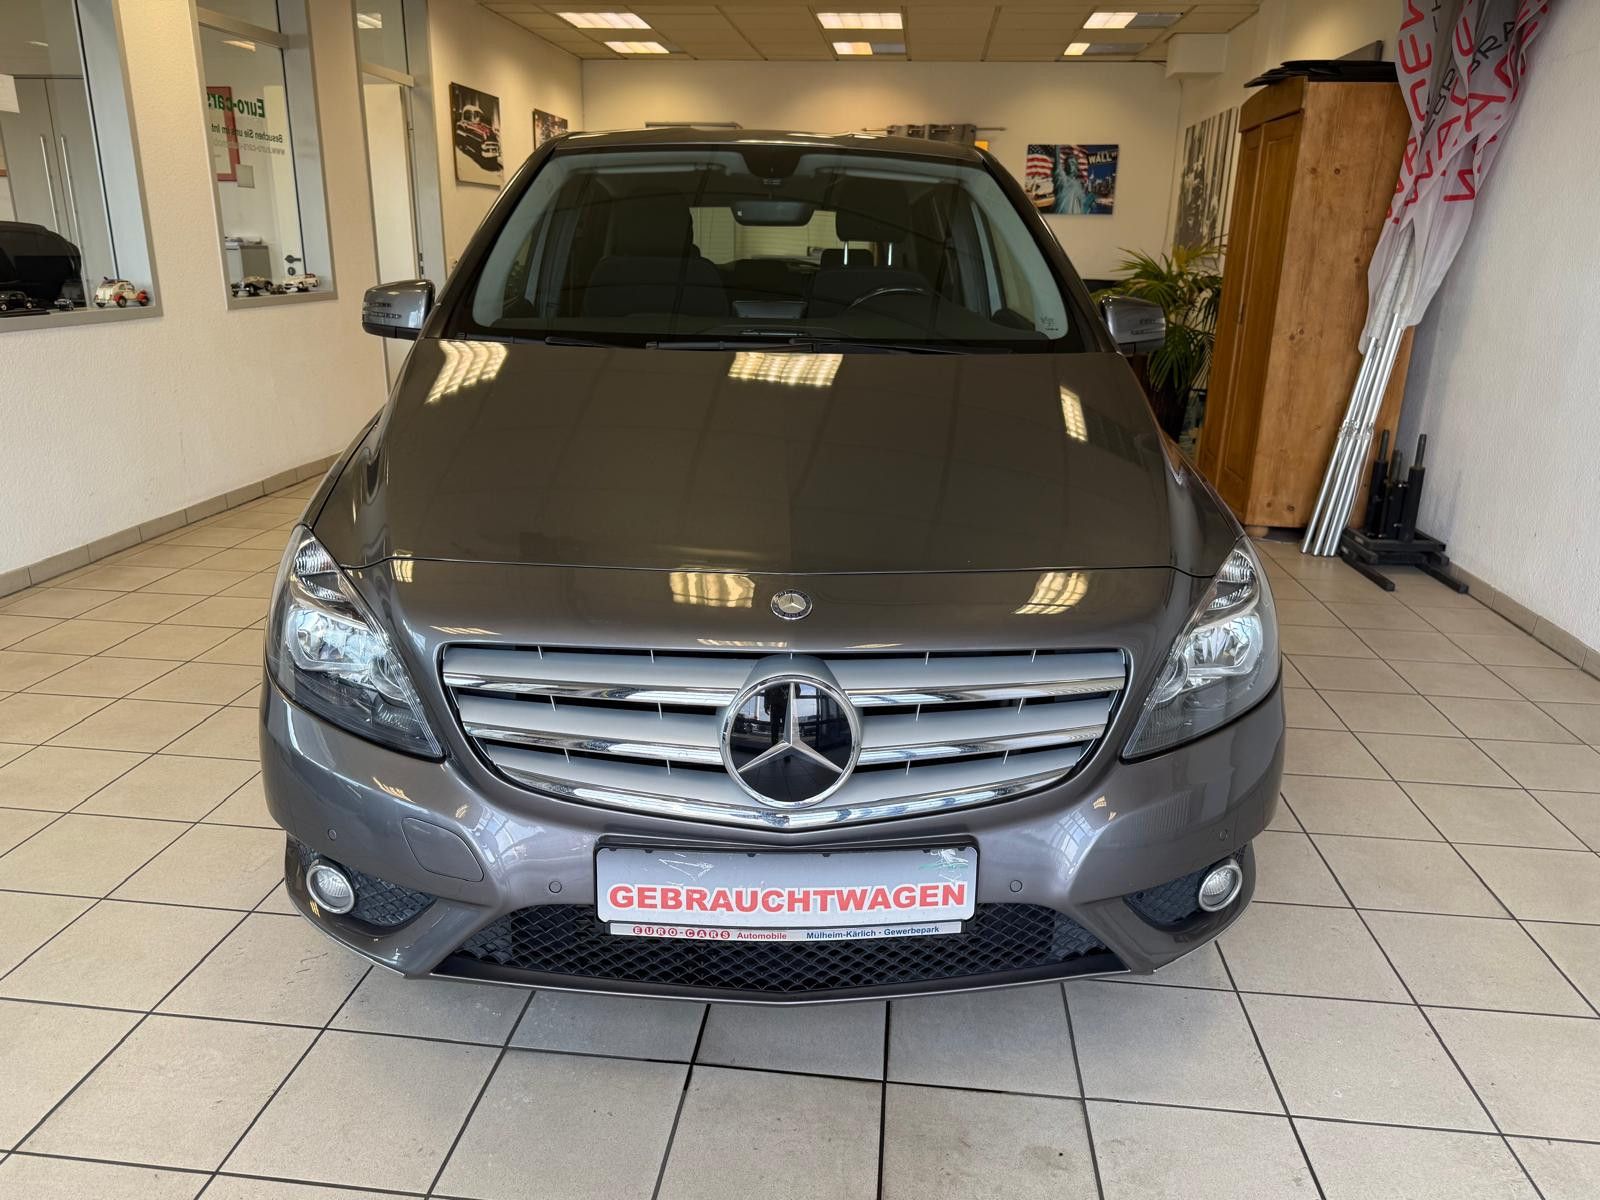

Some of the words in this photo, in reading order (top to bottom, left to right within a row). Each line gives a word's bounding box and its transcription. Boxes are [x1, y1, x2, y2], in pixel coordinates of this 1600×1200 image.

[1088, 150, 1113, 165] WALL
[609, 883, 965, 913] GEBRAUCHTWAGEN
[632, 925, 731, 940] EURO-CARS
[736, 931, 787, 940] Automobile
[806, 929, 876, 940] Mülheim-Kärlich
[883, 925, 940, 936] Gewerbepark
